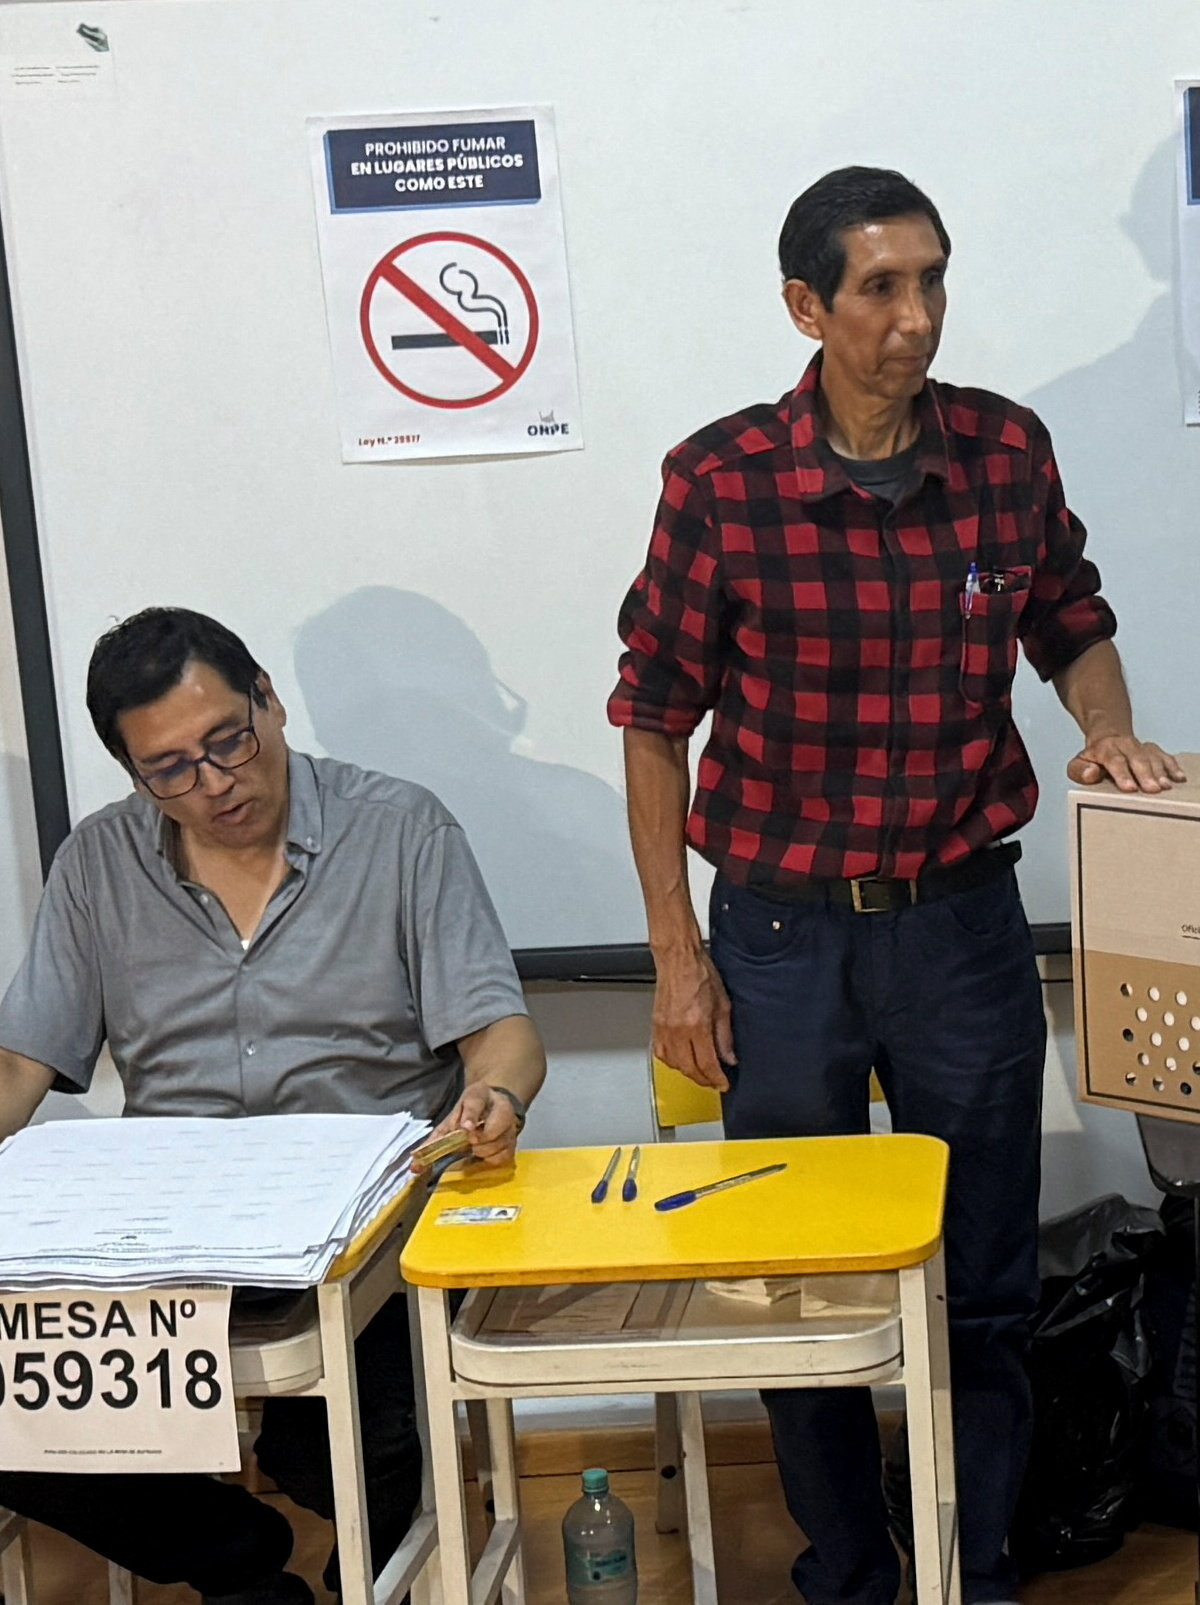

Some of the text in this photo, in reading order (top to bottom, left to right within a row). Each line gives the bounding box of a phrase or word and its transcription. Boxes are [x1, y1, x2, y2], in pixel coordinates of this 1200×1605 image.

[365, 135, 506, 158] PROHIBIDO FUMAR
[351, 153, 524, 176] EN LUGARES PÚBLICOS
[395, 174, 484, 192] COMO ESTE
[527, 423, 570, 437] ONPE
[0, 1300, 137, 1340] MESA
[0, 1348, 222, 1411] 59318
